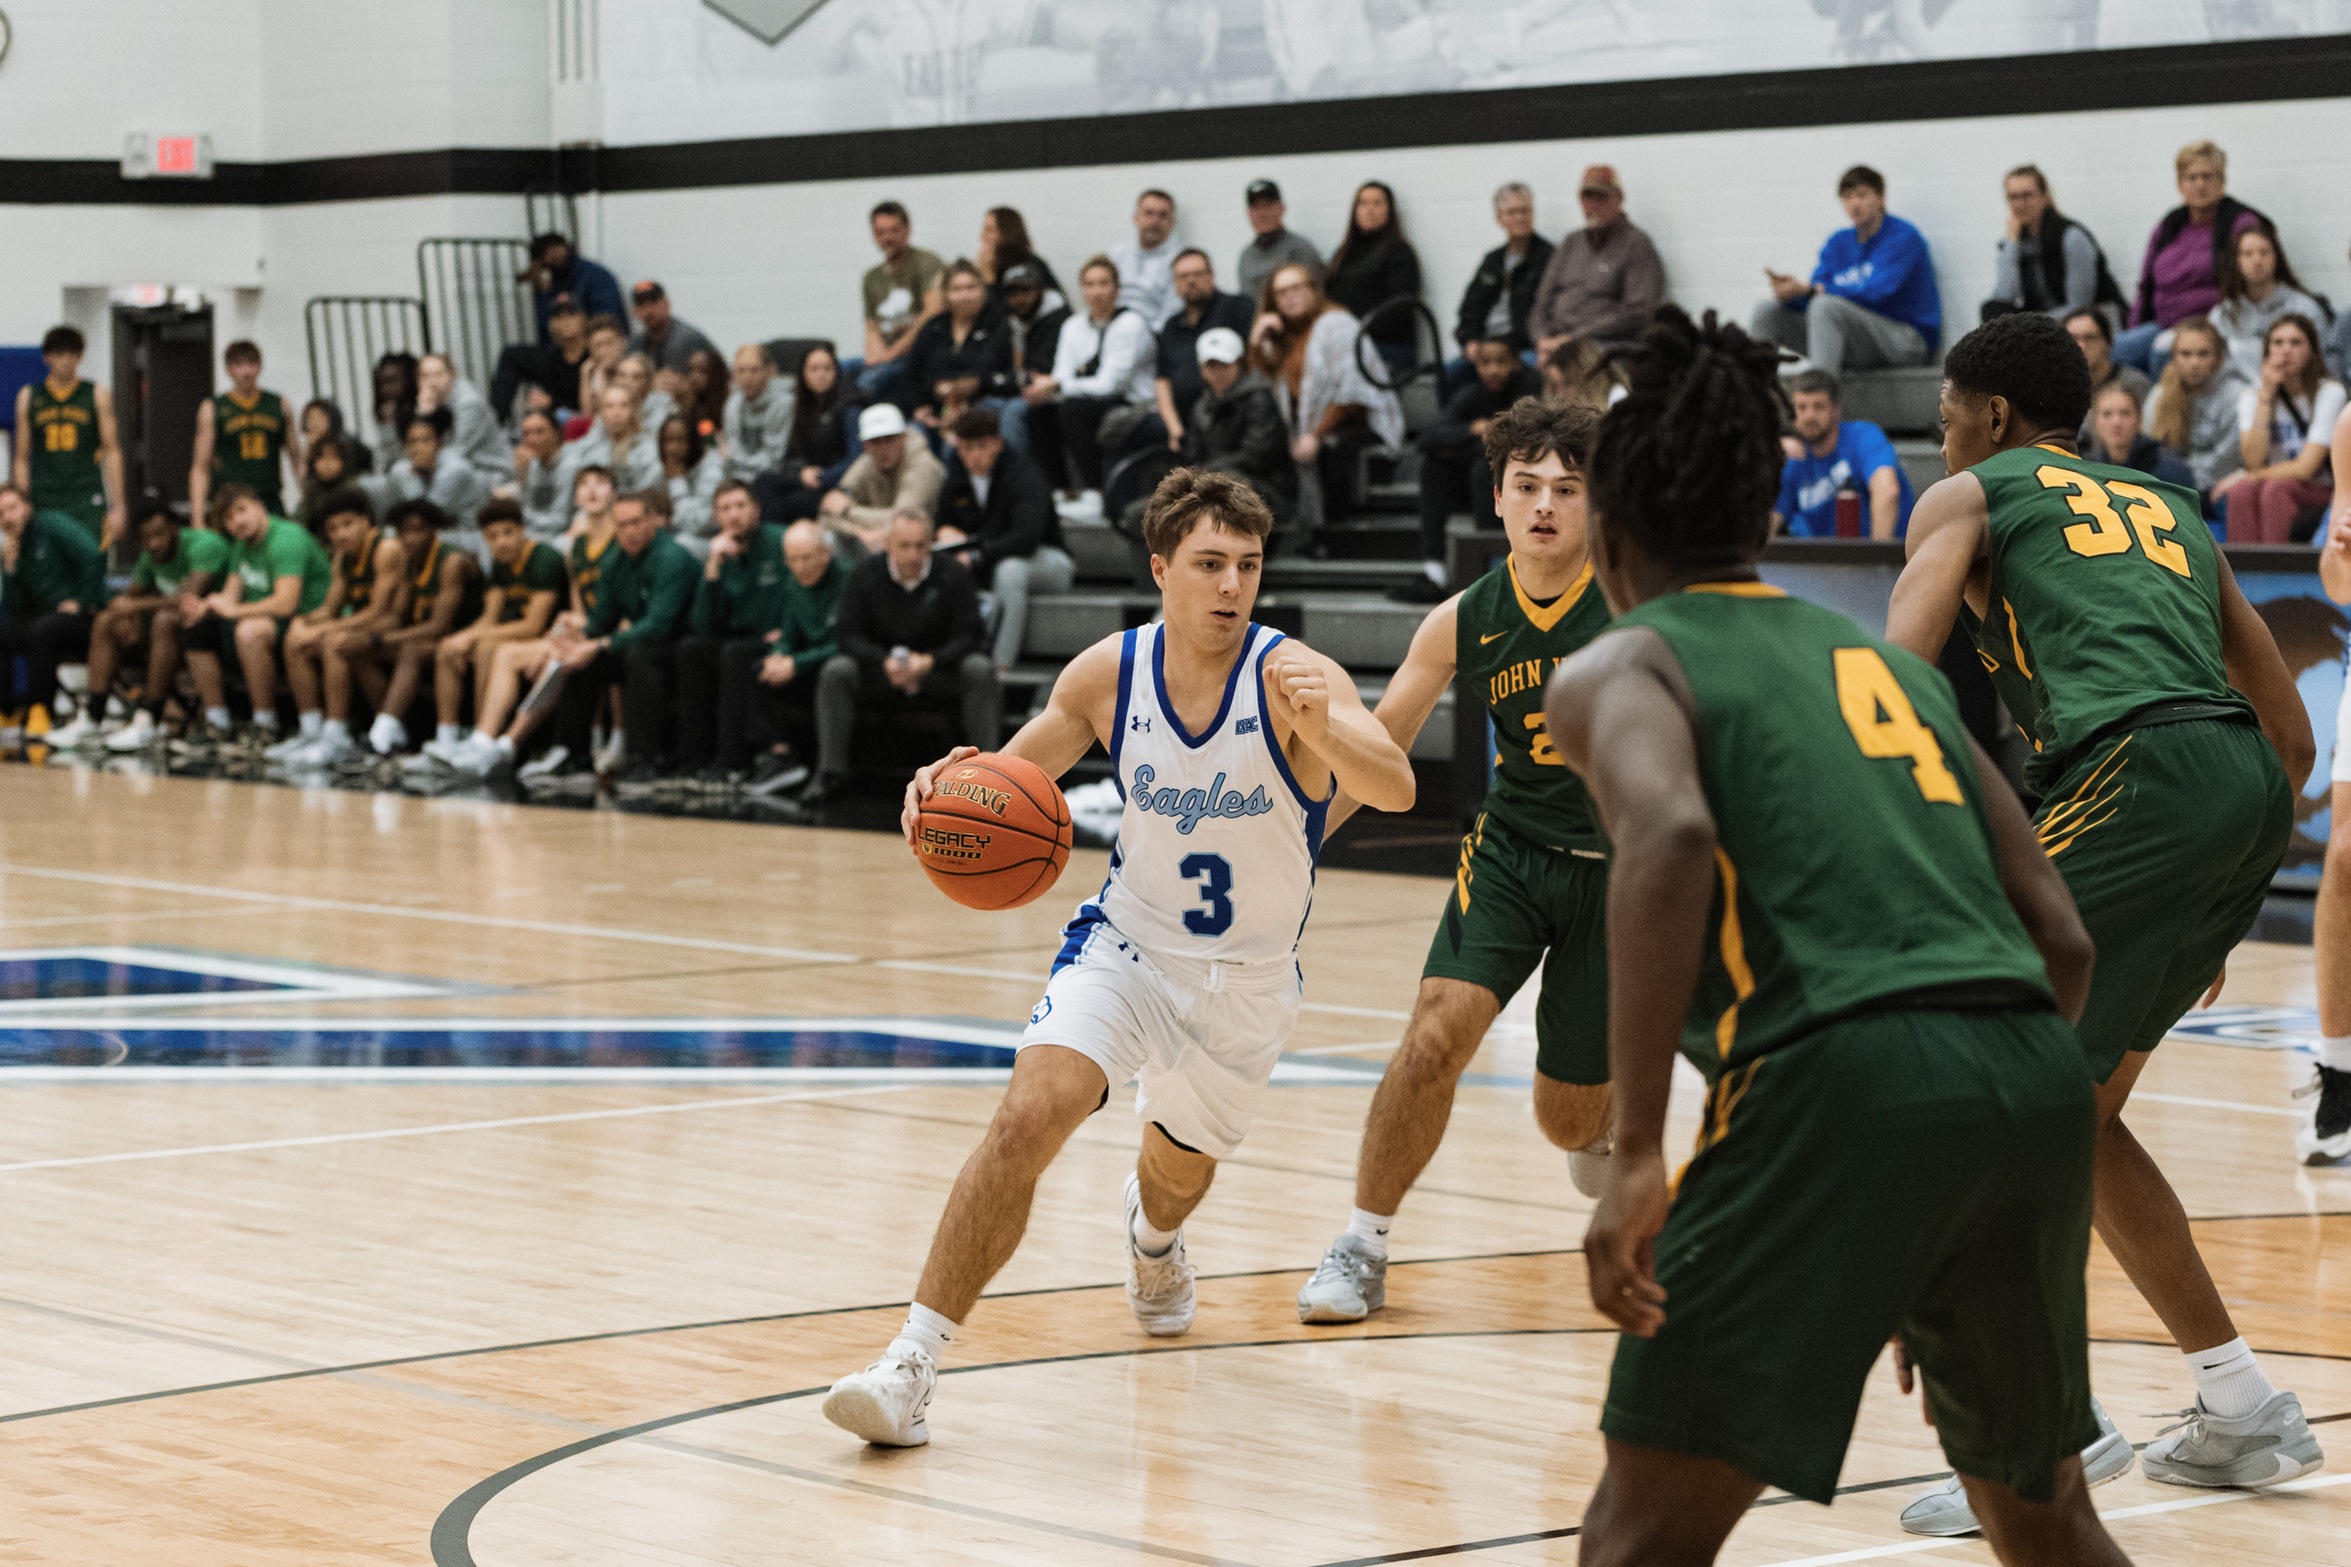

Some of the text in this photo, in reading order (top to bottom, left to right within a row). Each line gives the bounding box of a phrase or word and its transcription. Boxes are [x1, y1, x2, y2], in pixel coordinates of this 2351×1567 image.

[2033, 464, 2193, 580] 32
[1490, 658, 1542, 705] JOHN
[1831, 647, 1965, 807] 4
[933, 781, 1011, 817] PALDING
[1131, 764, 1274, 835] Eagles
[918, 824, 991, 849] LEGACY
[933, 846, 982, 859] 1000
[1177, 851, 1235, 938] 3
